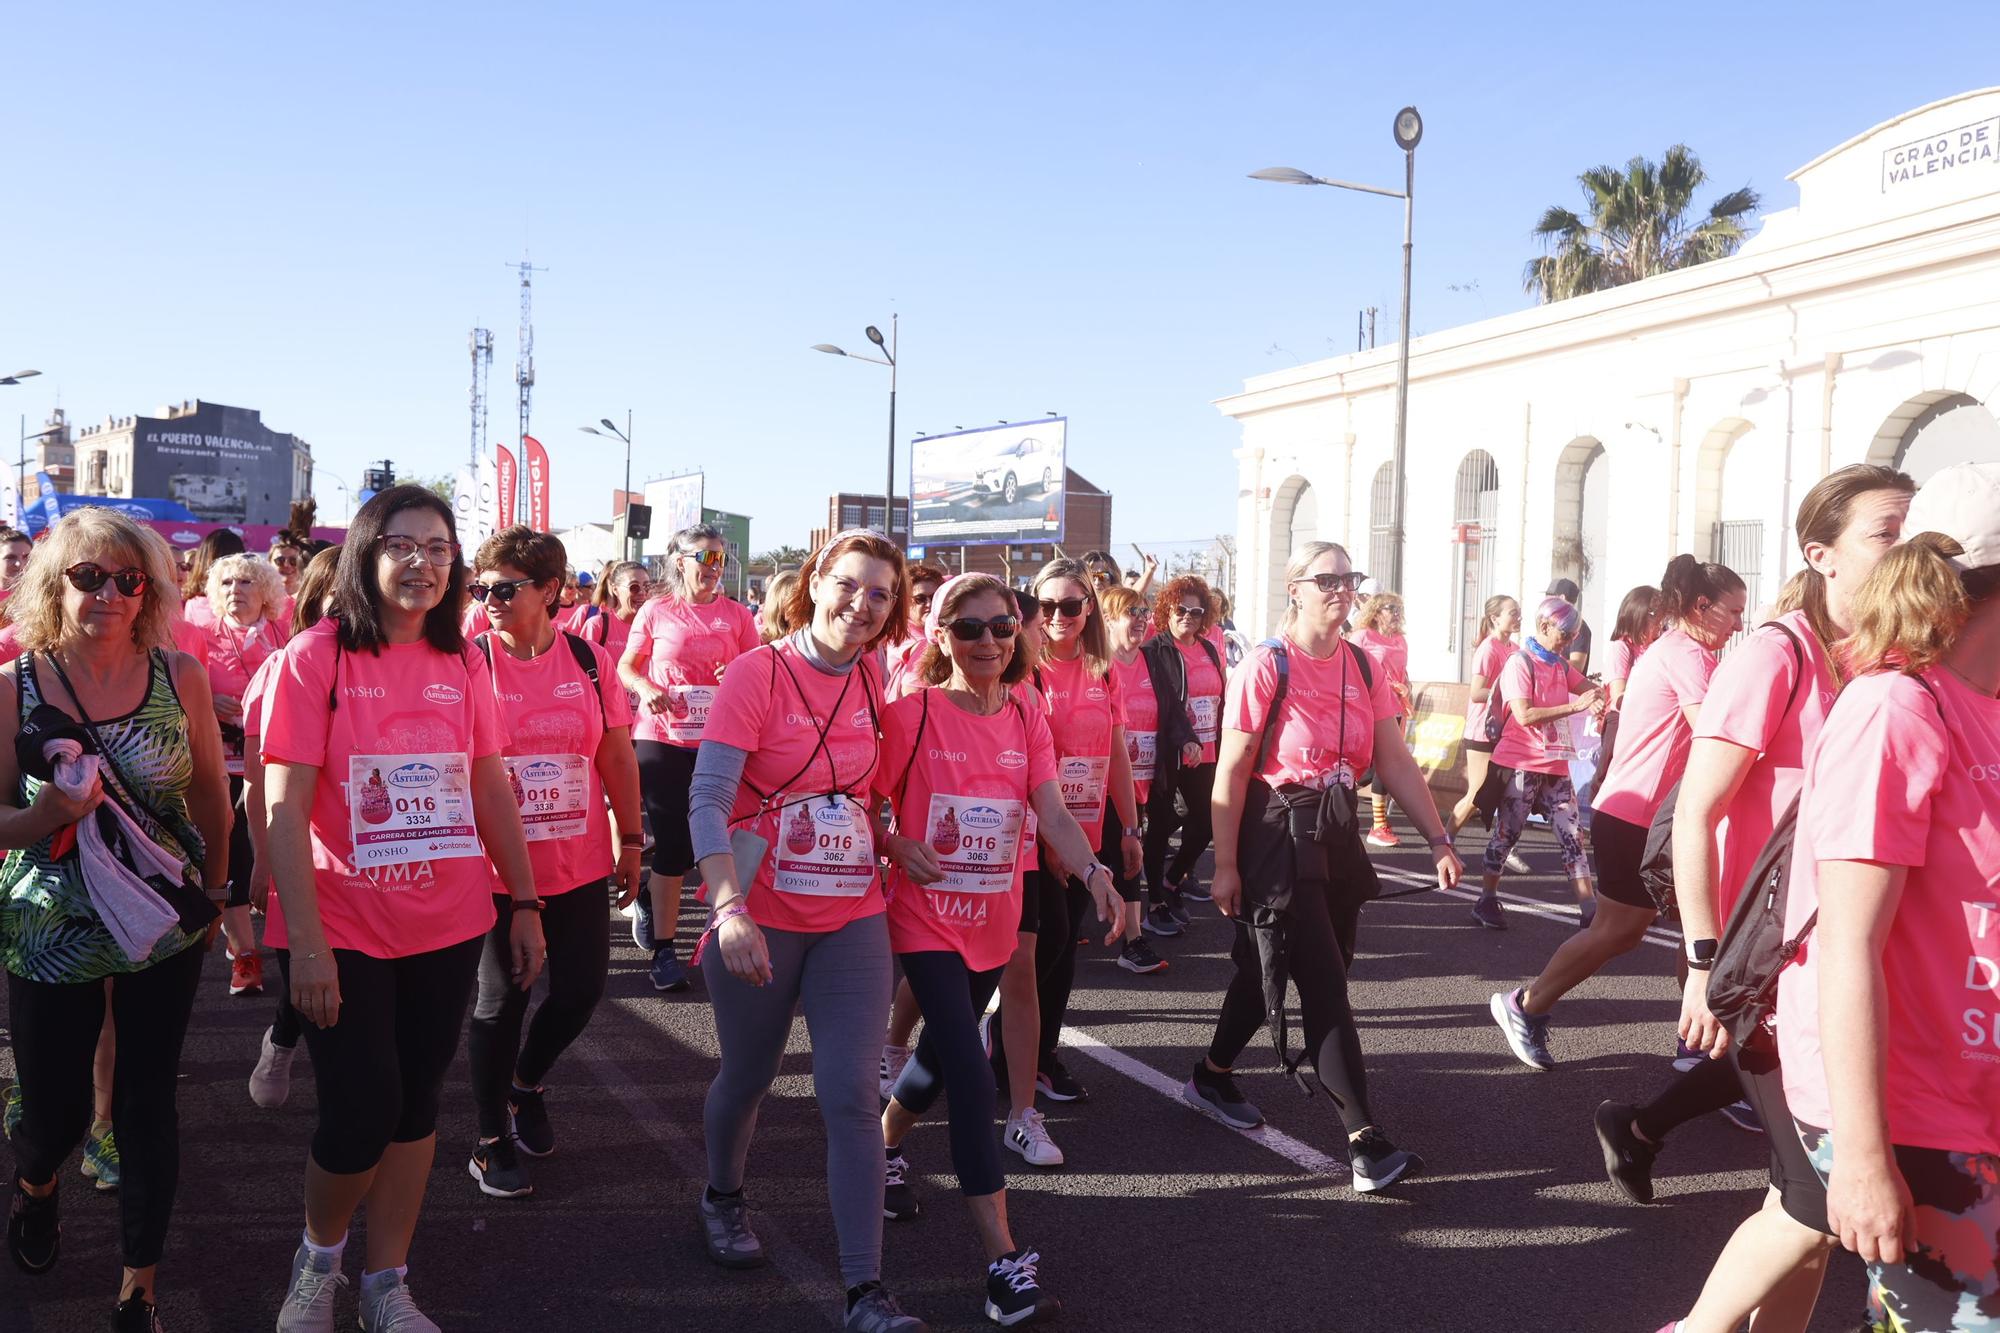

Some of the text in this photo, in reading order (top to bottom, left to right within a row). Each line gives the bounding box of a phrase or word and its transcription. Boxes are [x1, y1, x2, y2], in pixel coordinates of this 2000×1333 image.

[1893, 125, 1990, 166] GRAO DE
[1889, 144, 1992, 185] VALENCIA
[146, 433, 159, 442] EL
[161, 432, 202, 446] PUERTO
[1298, 747, 1324, 764] TU
[527, 787, 560, 801] 016
[1061, 783, 1084, 793] 016
[395, 796, 436, 812] 016
[534, 802, 554, 812] 3338
[405, 815, 431, 825] 3334
[963, 813, 1001, 824] ASTURIANA
[370, 832, 405, 841] CARRERA
[429, 828, 451, 836] MUJER
[439, 841, 472, 850] Santander
[818, 834, 852, 849] 016
[962, 835, 996, 850] 016
[368, 846, 408, 859] OYSHO
[824, 851, 845, 861] 3062
[967, 852, 988, 861] 3063
[790, 863, 820, 872] CARRERA
[785, 876, 819, 888] OYSHO
[926, 893, 987, 920] UMA
[1960, 1050, 2000, 1064] CARRER
